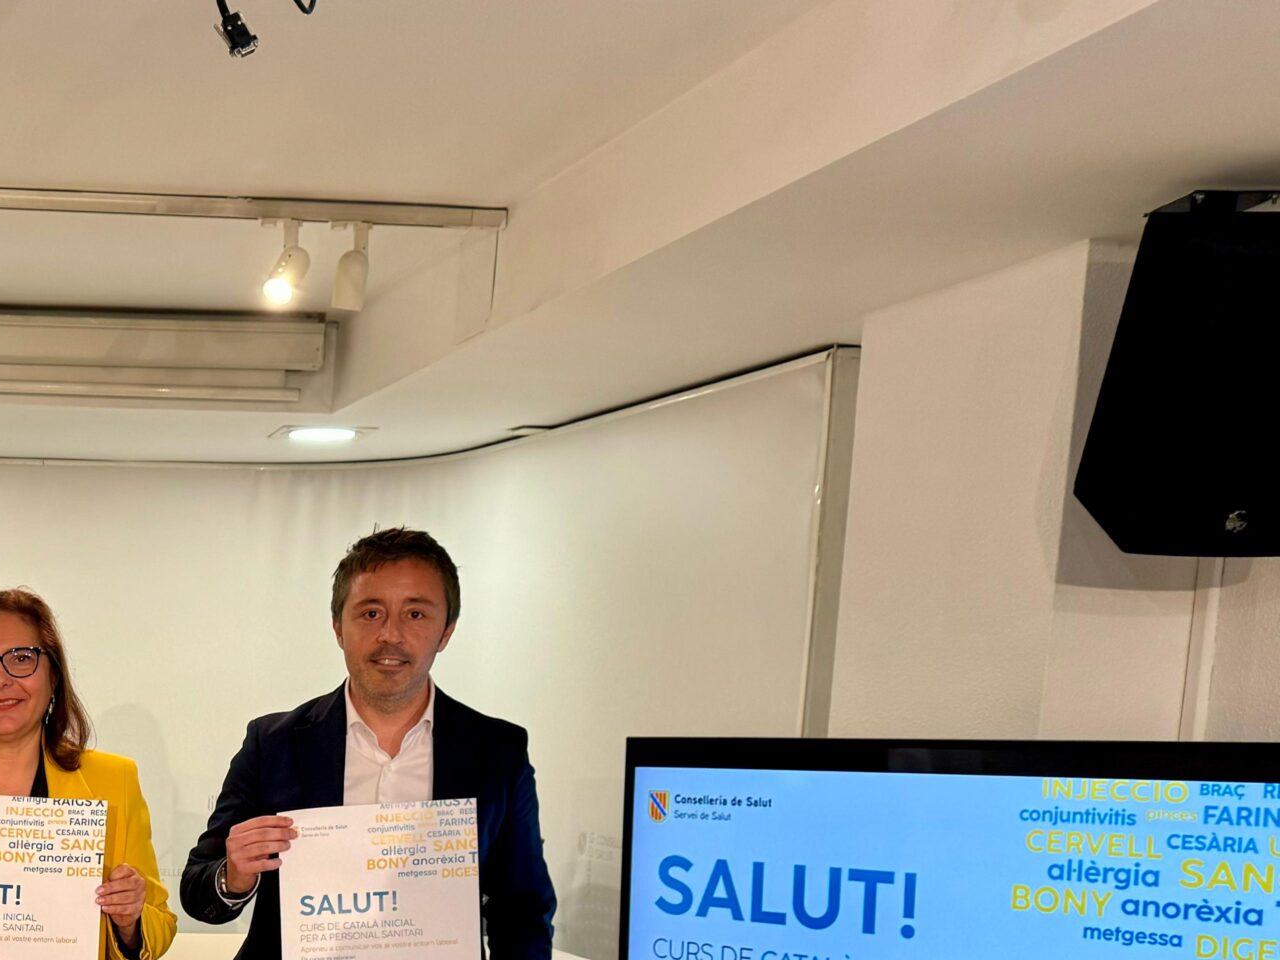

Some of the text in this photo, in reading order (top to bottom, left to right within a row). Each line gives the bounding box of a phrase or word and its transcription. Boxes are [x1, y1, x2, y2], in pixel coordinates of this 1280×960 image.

[1200, 783, 1245, 800] BRAÇ
[674, 794, 772, 808] Conselleria de Salut
[674, 810, 731, 821] Servei de Salut
[1019, 806, 1137, 827] conjuntivitis
[1146, 809, 1198, 822] pinces
[0, 827, 55, 840] CERVELL
[368, 824, 415, 833] conjuntivitis
[1026, 830, 1163, 859] CERVELL
[1166, 832, 1259, 855] CESÀRIA
[39, 854, 91, 863] anorèxia
[367, 854, 465, 870] BONY anorèxia
[24, 866, 62, 874] metgessa
[398, 869, 437, 878] metgessa
[1179, 858, 1280, 894] SAN
[300, 890, 398, 916] SALUT!
[654, 854, 917, 940] SALUT!
[1011, 884, 1264, 926] BONY anorèxia
[3, 913, 37, 921] INICIAL
[3, 923, 44, 932] SANITARI
[300, 919, 415, 932] CURS DE CATALÀ INICIAL
[300, 928, 423, 943] PER A PERSONAL SANITARI
[1082, 925, 1183, 948] metgessa
